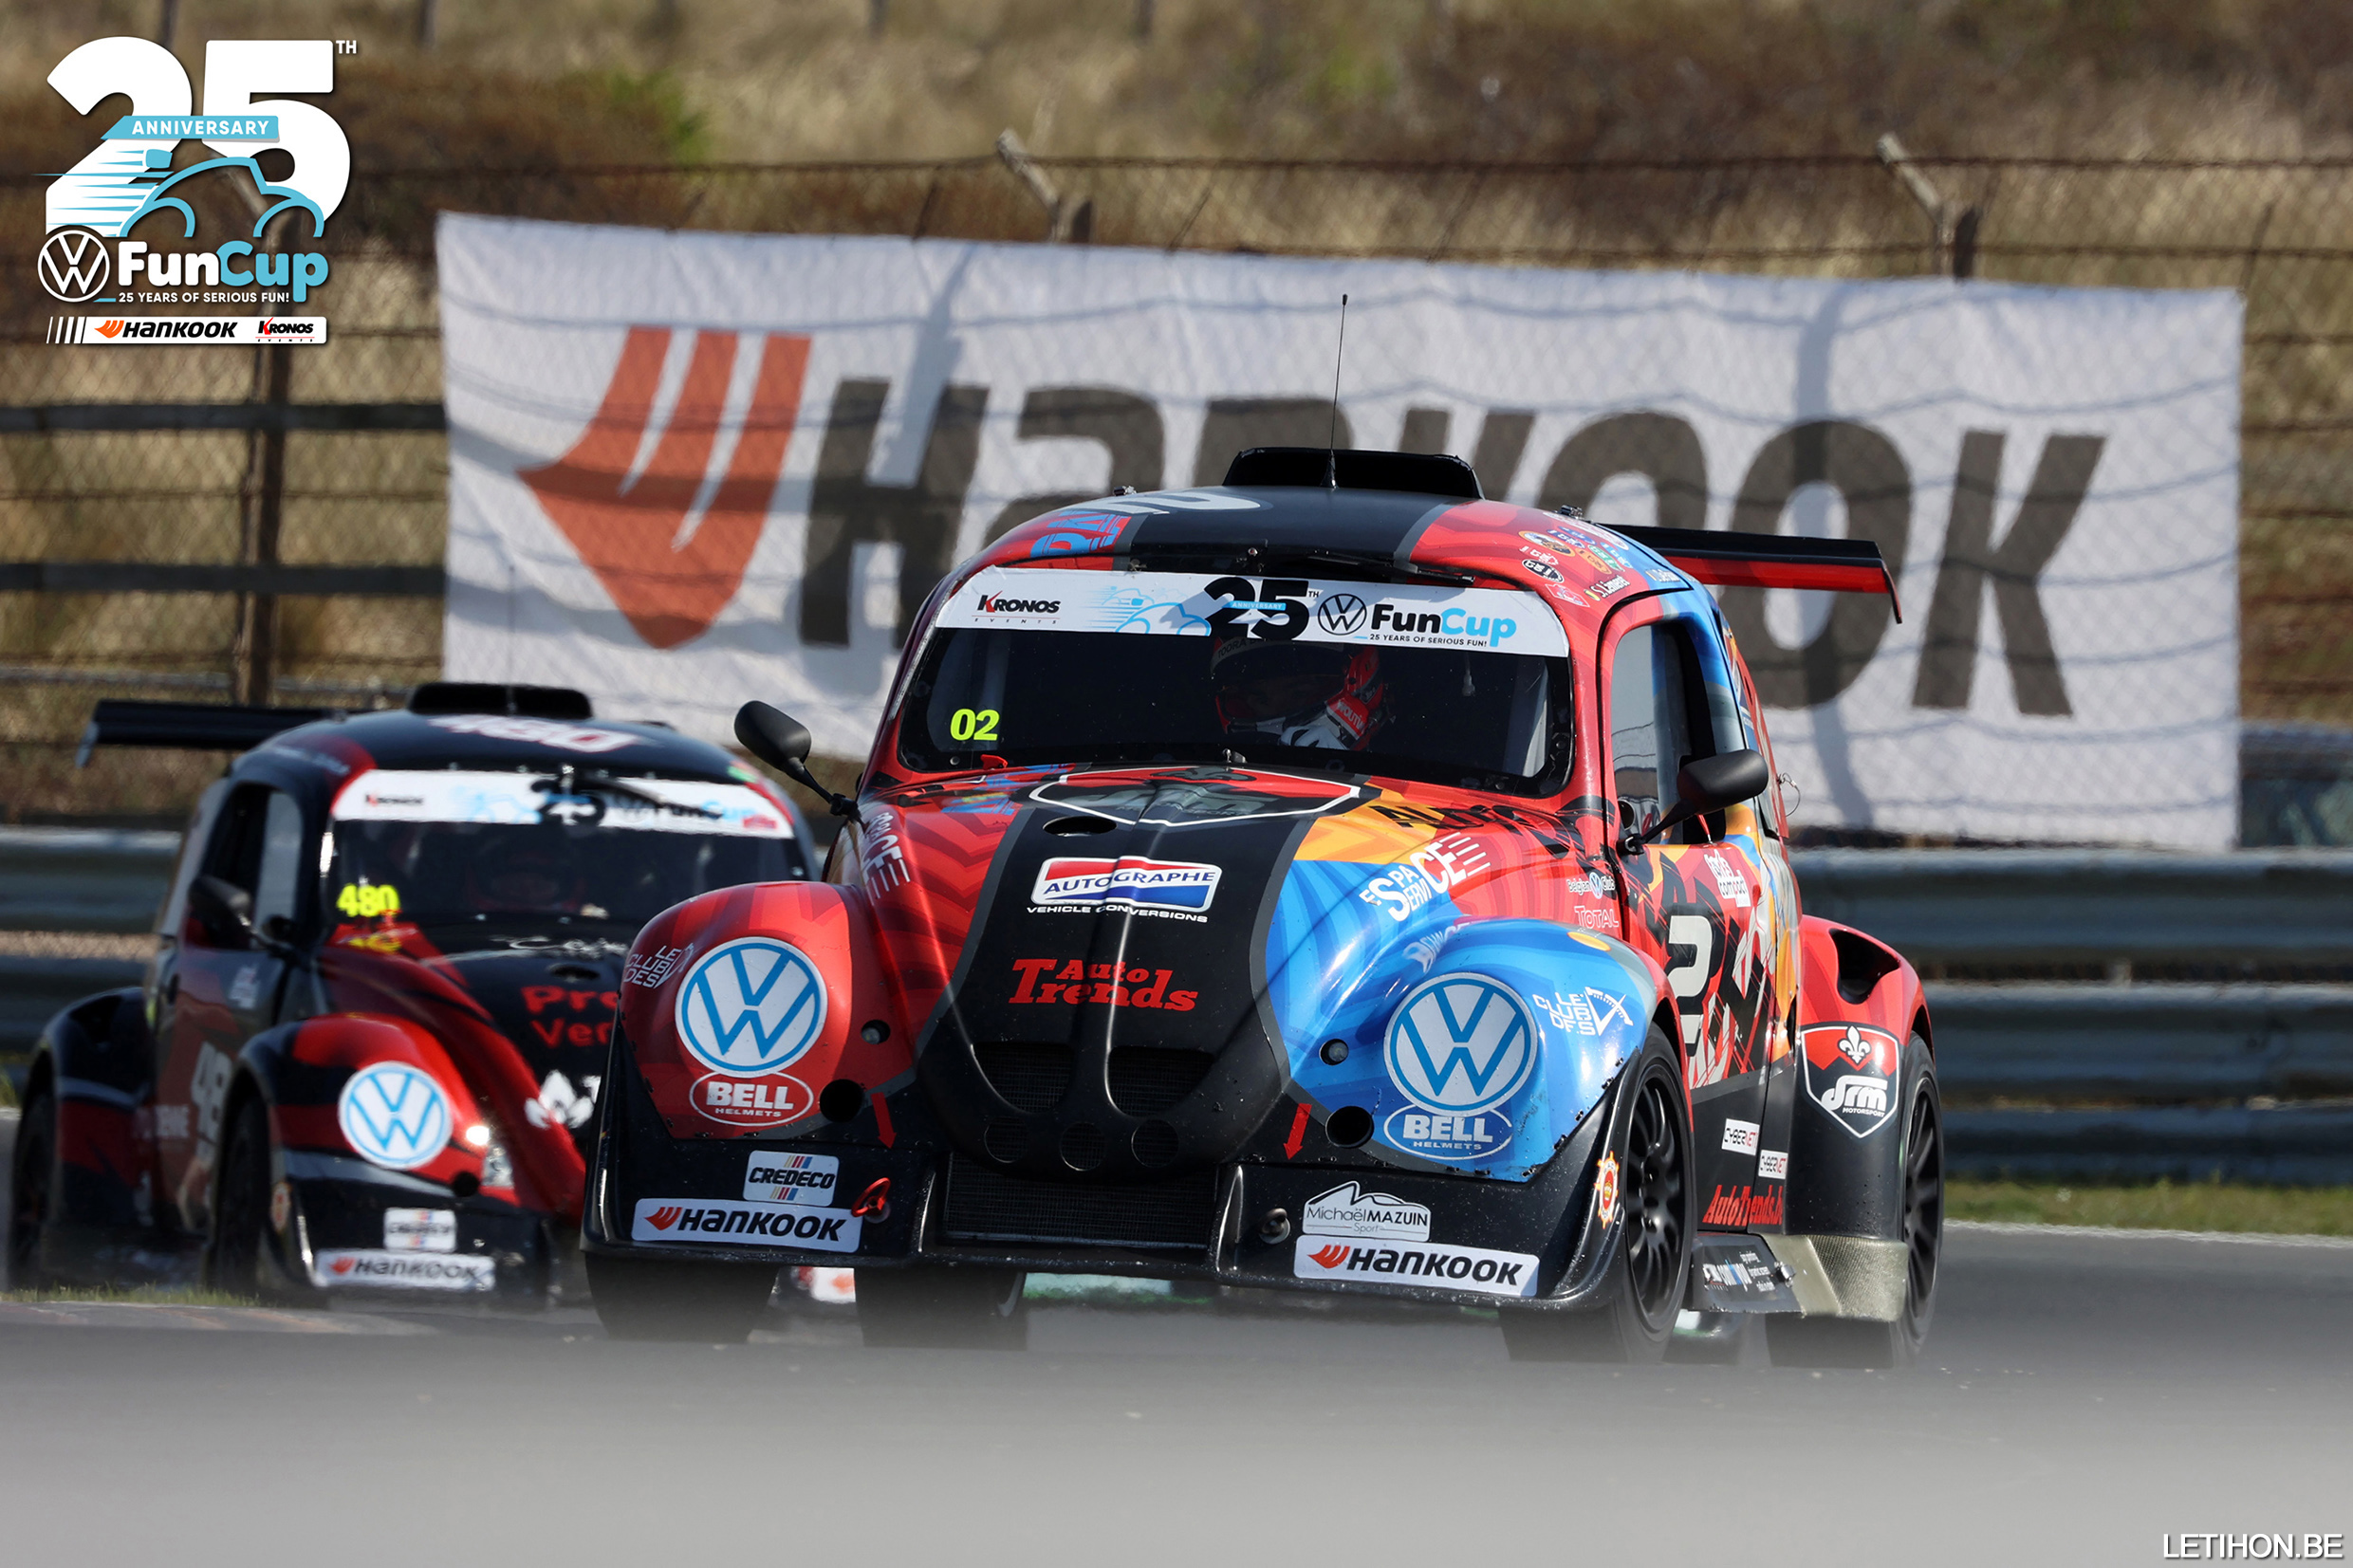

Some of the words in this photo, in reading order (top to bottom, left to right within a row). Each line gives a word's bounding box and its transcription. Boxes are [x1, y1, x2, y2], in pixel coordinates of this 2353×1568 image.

[977, 590, 1061, 613] KRONOS
[1203, 577, 1309, 640] 25
[1308, 589, 1320, 598] TH
[1232, 601, 1283, 610] ANNIVERSARY
[1371, 604, 1516, 647] FunCup
[951, 709, 999, 741] 02
[1043, 871, 1215, 895] AUTOGRAPHE
[1566, 877, 1591, 895] Belgian
[1601, 876, 1615, 891] Club
[337, 884, 399, 917] 480
[1096, 905, 1208, 923] CONVERSIONS
[1574, 906, 1619, 929] TOTAL
[625, 953, 671, 974] CLUB
[656, 945, 681, 962] LE
[623, 968, 659, 988] DES
[1056, 959, 1149, 983] Auto
[1009, 959, 1198, 1011] Trends
[1532, 994, 1591, 1021] CLUB
[1555, 992, 1584, 1005] LE
[706, 1081, 794, 1110] BELL
[715, 1108, 782, 1117] HELMETS
[1843, 1108, 1885, 1118] MOTORSPORT
[1403, 1115, 1493, 1142] BELL
[1414, 1141, 1482, 1150] HELMETS
[749, 1167, 836, 1189] CREDECO
[1306, 1207, 1366, 1223] Michaël
[1367, 1211, 1428, 1227] MAZUIN
[1354, 1223, 1379, 1233] Sport
